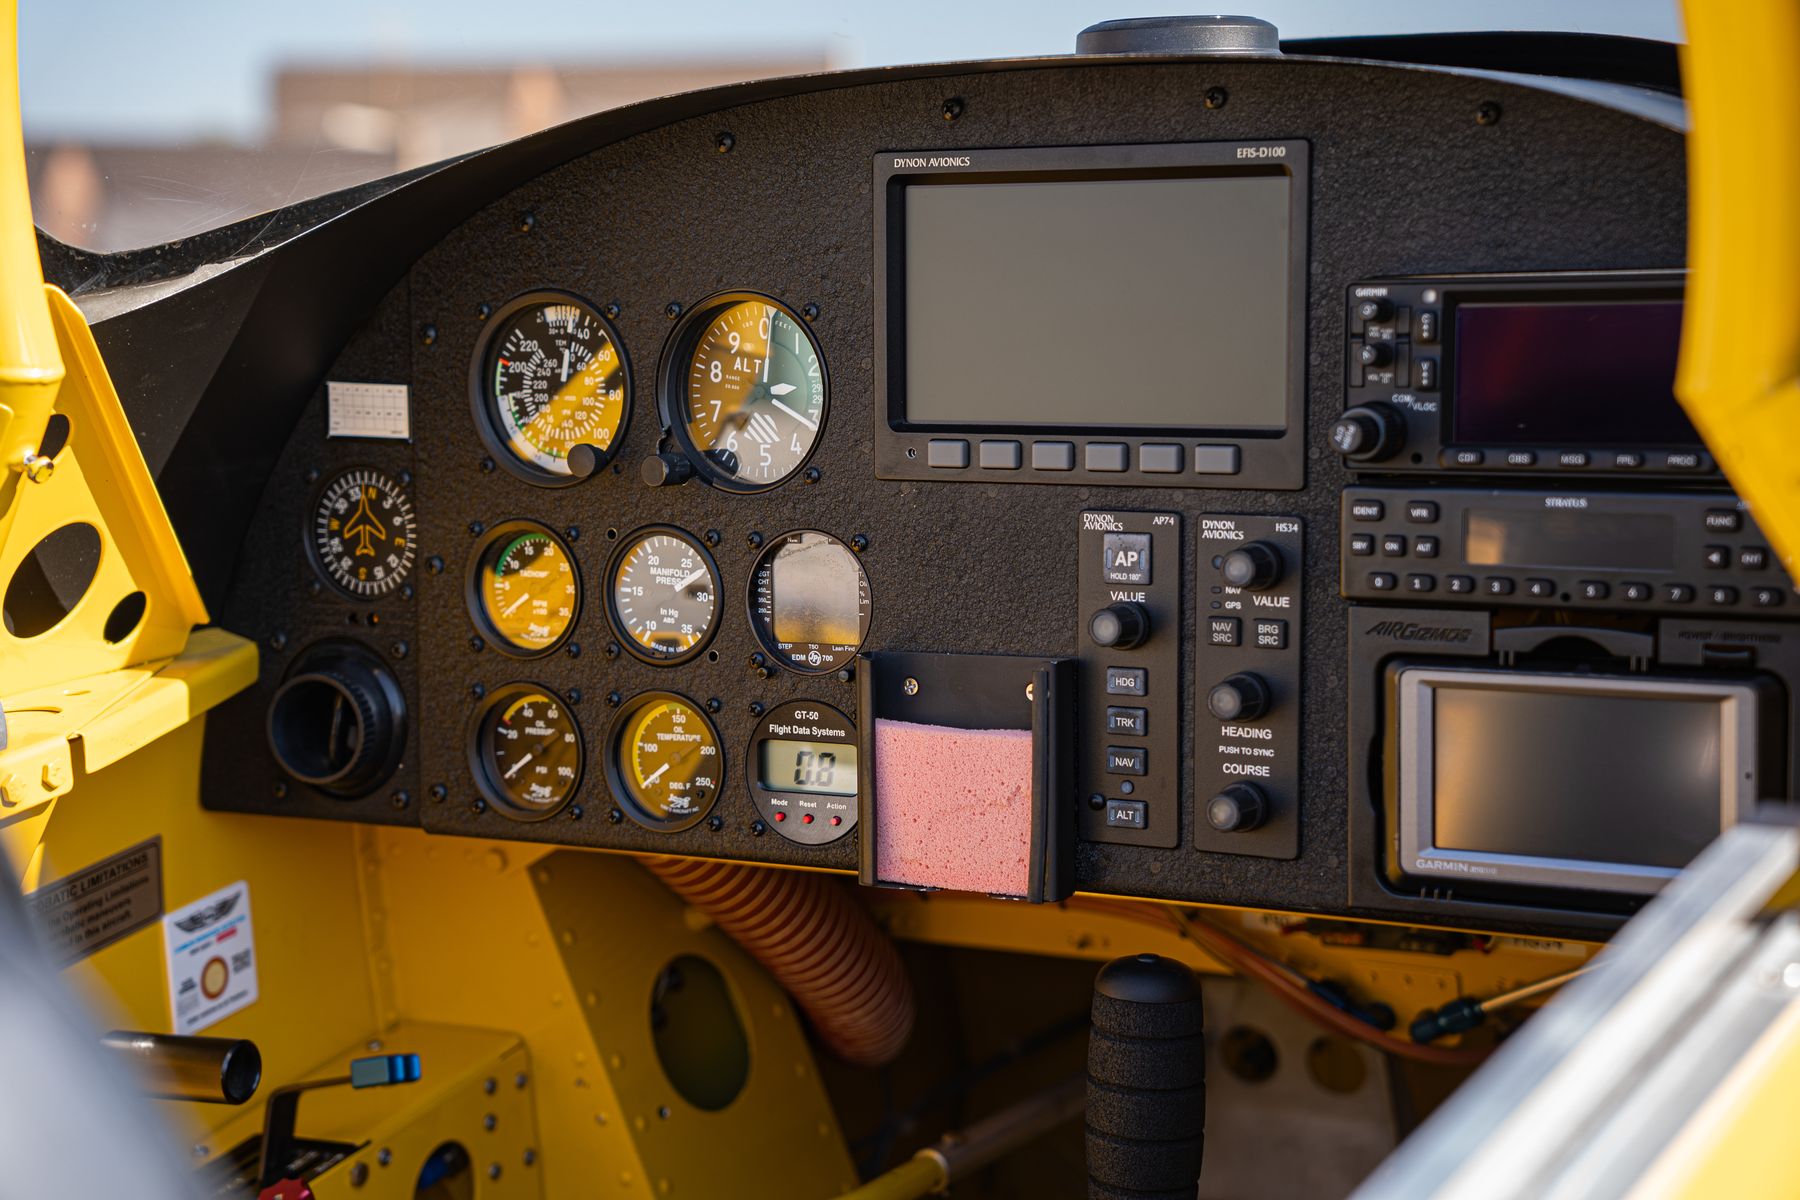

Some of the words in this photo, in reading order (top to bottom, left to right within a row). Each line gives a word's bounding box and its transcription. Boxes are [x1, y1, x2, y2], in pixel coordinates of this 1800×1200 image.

[1237, 146, 1286, 158] EFIS-D100
[894, 158, 926, 168] DYNON
[928, 156, 970, 166] AVIONICS
[1356, 288, 1388, 297] GARMIN
[577, 328, 590, 340] 40
[759, 318, 769, 340] 0
[520, 340, 538, 352] 220
[728, 332, 740, 354] 9
[598, 350, 610, 360] 60
[509, 362, 526, 372] 200
[543, 359, 558, 368] 260
[577, 362, 586, 370] 60
[734, 356, 762, 374] ALT
[808, 355, 820, 377] 2
[537, 368, 551, 376] 240
[710, 361, 722, 383] 8
[533, 381, 547, 389] 220
[584, 377, 594, 386] 80
[534, 394, 548, 402] 200
[608, 390, 620, 400] 80
[582, 398, 595, 406] 100
[538, 404, 550, 413] 180
[710, 400, 722, 422] 7
[575, 412, 587, 420] 120
[593, 428, 610, 440] 100
[726, 431, 738, 452] 6
[790, 433, 802, 455] 4
[760, 444, 772, 466] 5
[368, 487, 377, 500] N
[1545, 498, 1588, 508] STRATUS
[1352, 506, 1380, 516] IDENT
[1084, 514, 1114, 523] DYNON
[1152, 516, 1174, 526] AP74
[1084, 521, 1124, 531] AVIONICS
[1202, 520, 1235, 530] DYNON
[1276, 522, 1298, 533] HS34
[1202, 530, 1244, 540] AVIONICS
[394, 537, 406, 548] E
[544, 548, 554, 556] 20
[648, 556, 659, 566] 20
[681, 558, 692, 568] 25
[1114, 550, 1138, 567] AP
[510, 560, 519, 570] 10
[358, 566, 368, 581] S
[650, 567, 690, 578] MANIFOLD
[1110, 572, 1128, 580] HOLD
[1374, 577, 1384, 588] 0
[1414, 578, 1421, 589] 1
[1452, 580, 1460, 590] 2
[1492, 581, 1500, 592] 3
[632, 586, 643, 596] 15
[1225, 586, 1242, 594] NAV
[1531, 583, 1540, 594] 4
[1628, 586, 1638, 598] 6
[696, 592, 708, 602] 30
[1110, 590, 1146, 602] VALUE
[1672, 588, 1682, 600] 7
[1225, 601, 1242, 610] GPS
[1252, 595, 1290, 608] VALUE
[660, 608, 667, 616] In
[668, 608, 678, 618] Hg
[646, 620, 656, 630] 10
[681, 624, 692, 634] 35
[1212, 622, 1232, 632] NAV
[1258, 624, 1278, 634] BRG
[1212, 632, 1232, 643] SRC
[1258, 635, 1279, 645] SRC
[651, 642, 666, 652] MADE
[1116, 678, 1134, 688] HDG
[522, 709, 533, 718] 40
[548, 709, 558, 718] 60
[794, 711, 819, 720] GT-50
[672, 714, 686, 724] 150
[1116, 717, 1134, 728] TRK
[507, 730, 518, 739] 20
[769, 724, 792, 736] Flight
[793, 726, 810, 735] Data
[812, 727, 846, 738] Systems
[1222, 726, 1272, 740] HEADING
[564, 733, 575, 742] 80
[644, 743, 658, 752] 100
[700, 746, 716, 756] 200
[1219, 745, 1240, 755] PUSH
[1241, 747, 1252, 756] TO
[1253, 748, 1274, 757] SYNC
[1116, 758, 1134, 768] NAV
[536, 766, 548, 774] PSI
[558, 766, 572, 776] 100
[1222, 763, 1270, 777] COURSE
[696, 777, 710, 786] 250
[771, 798, 788, 806] Mode
[800, 800, 817, 808] Reset
[826, 802, 847, 810] Action
[1116, 810, 1134, 820] ALT
[1416, 859, 1470, 872] GARMIN
[80, 852, 148, 893] LIMITATIONS
